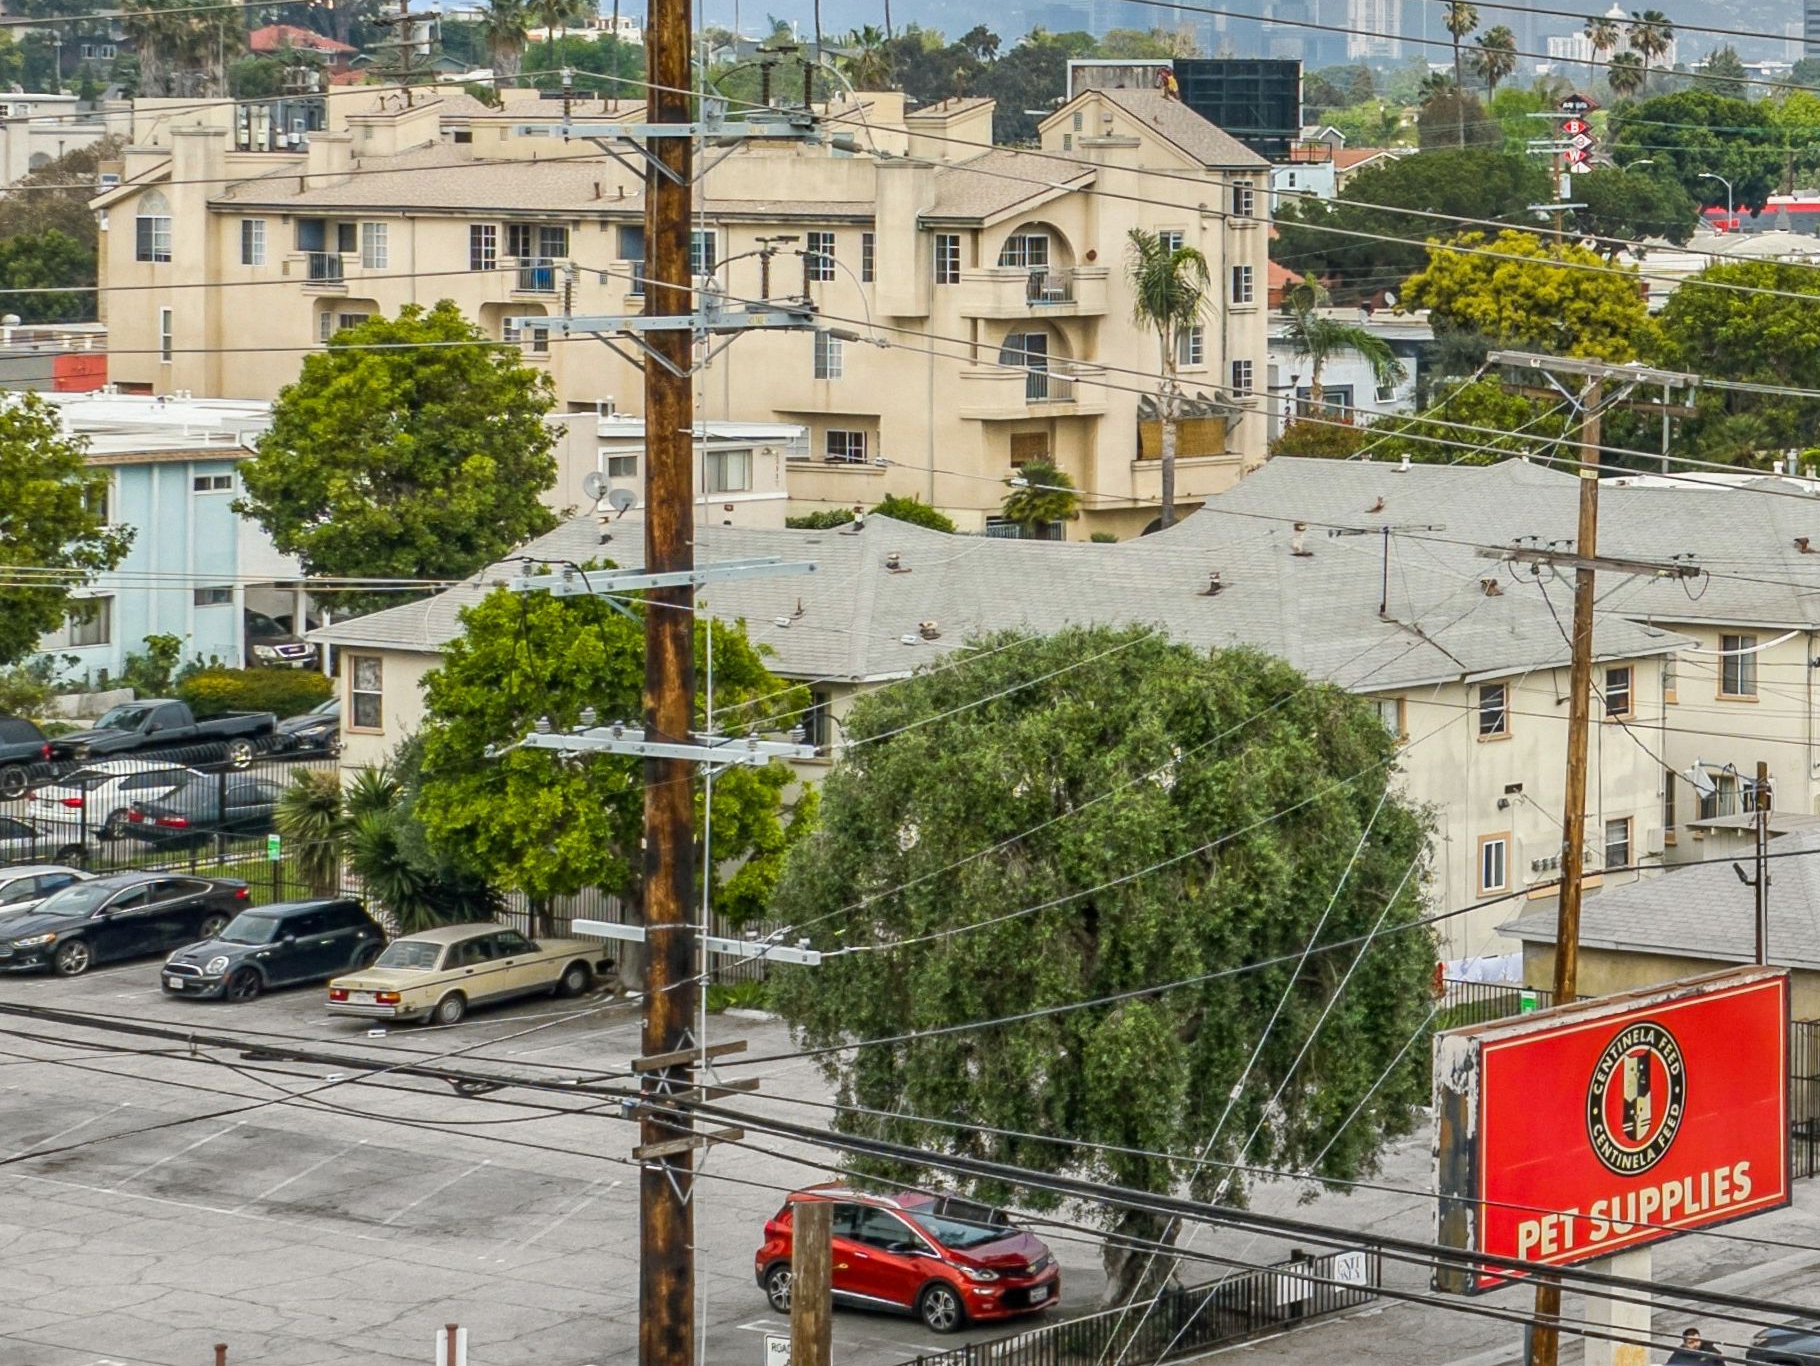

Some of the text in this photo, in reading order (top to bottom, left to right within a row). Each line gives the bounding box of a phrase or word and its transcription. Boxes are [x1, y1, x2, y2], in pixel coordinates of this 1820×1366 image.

[1593, 1028, 1680, 1094] CENTINELA FEED
[1593, 1104, 1680, 1169] CENTINELA FEED
[1518, 1161, 1752, 1259] PET SUPPLIES
